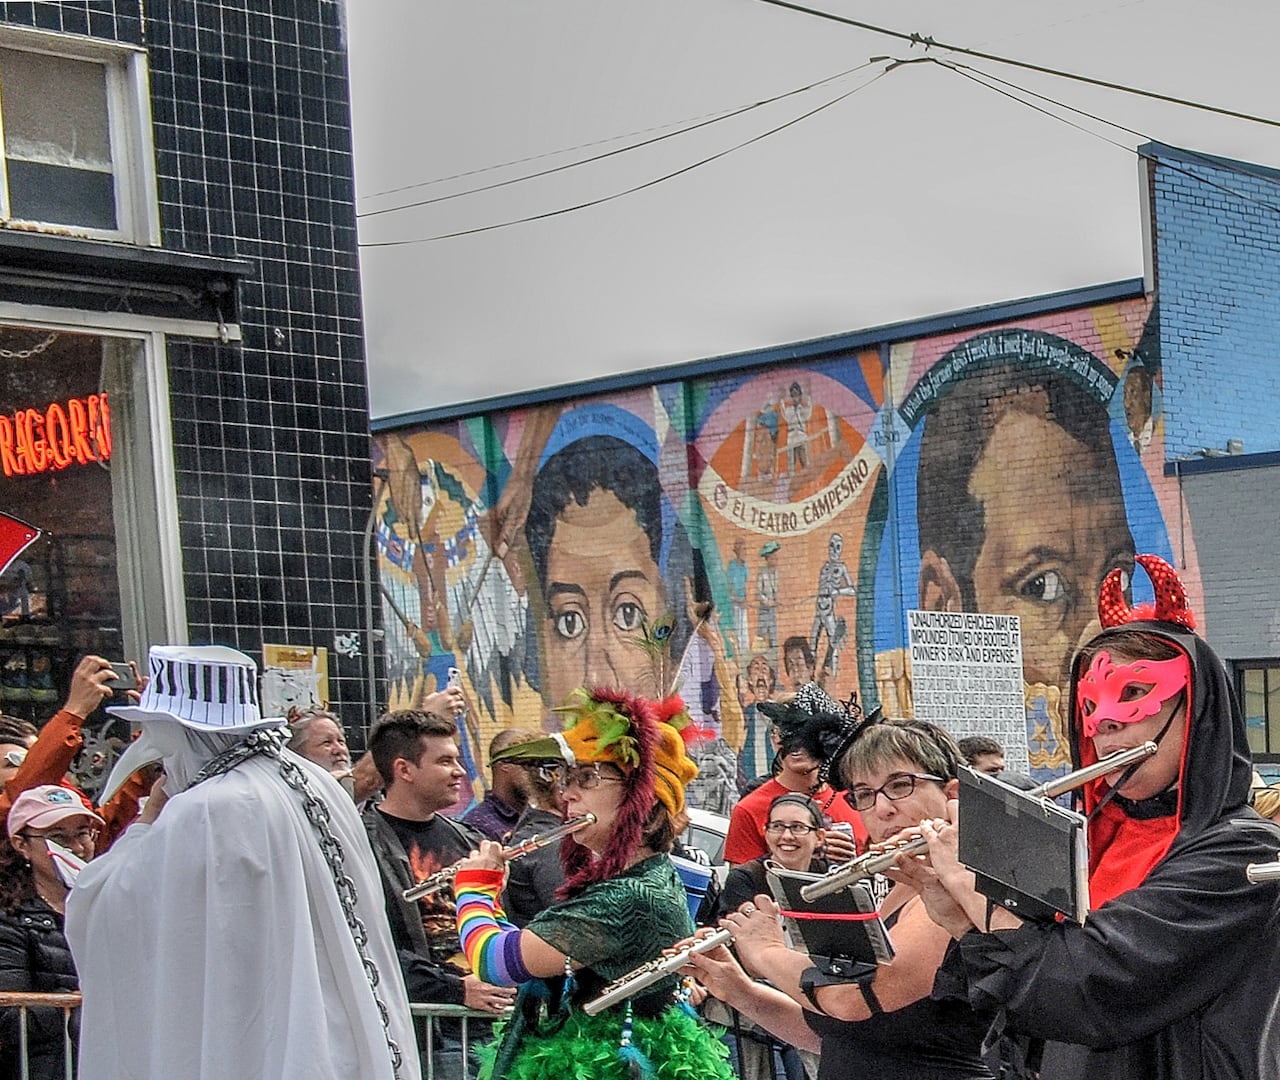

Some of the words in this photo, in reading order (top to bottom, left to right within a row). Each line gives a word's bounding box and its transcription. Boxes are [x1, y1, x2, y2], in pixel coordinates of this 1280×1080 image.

[732, 499, 746, 521] EL
[751, 507, 797, 534] TEATRO
[803, 459, 869, 524] CAMPESINO
[963, 614, 994, 631] VEHICLES
[995, 616, 1008, 631] MAY
[1009, 617, 1019, 631] BE
[911, 629, 947, 645] IMPOUNDED
[974, 632, 983, 646] OR
[1011, 633, 1019, 647] AT
[948, 647, 965, 662] RISK
[965, 647, 981, 662] AND
